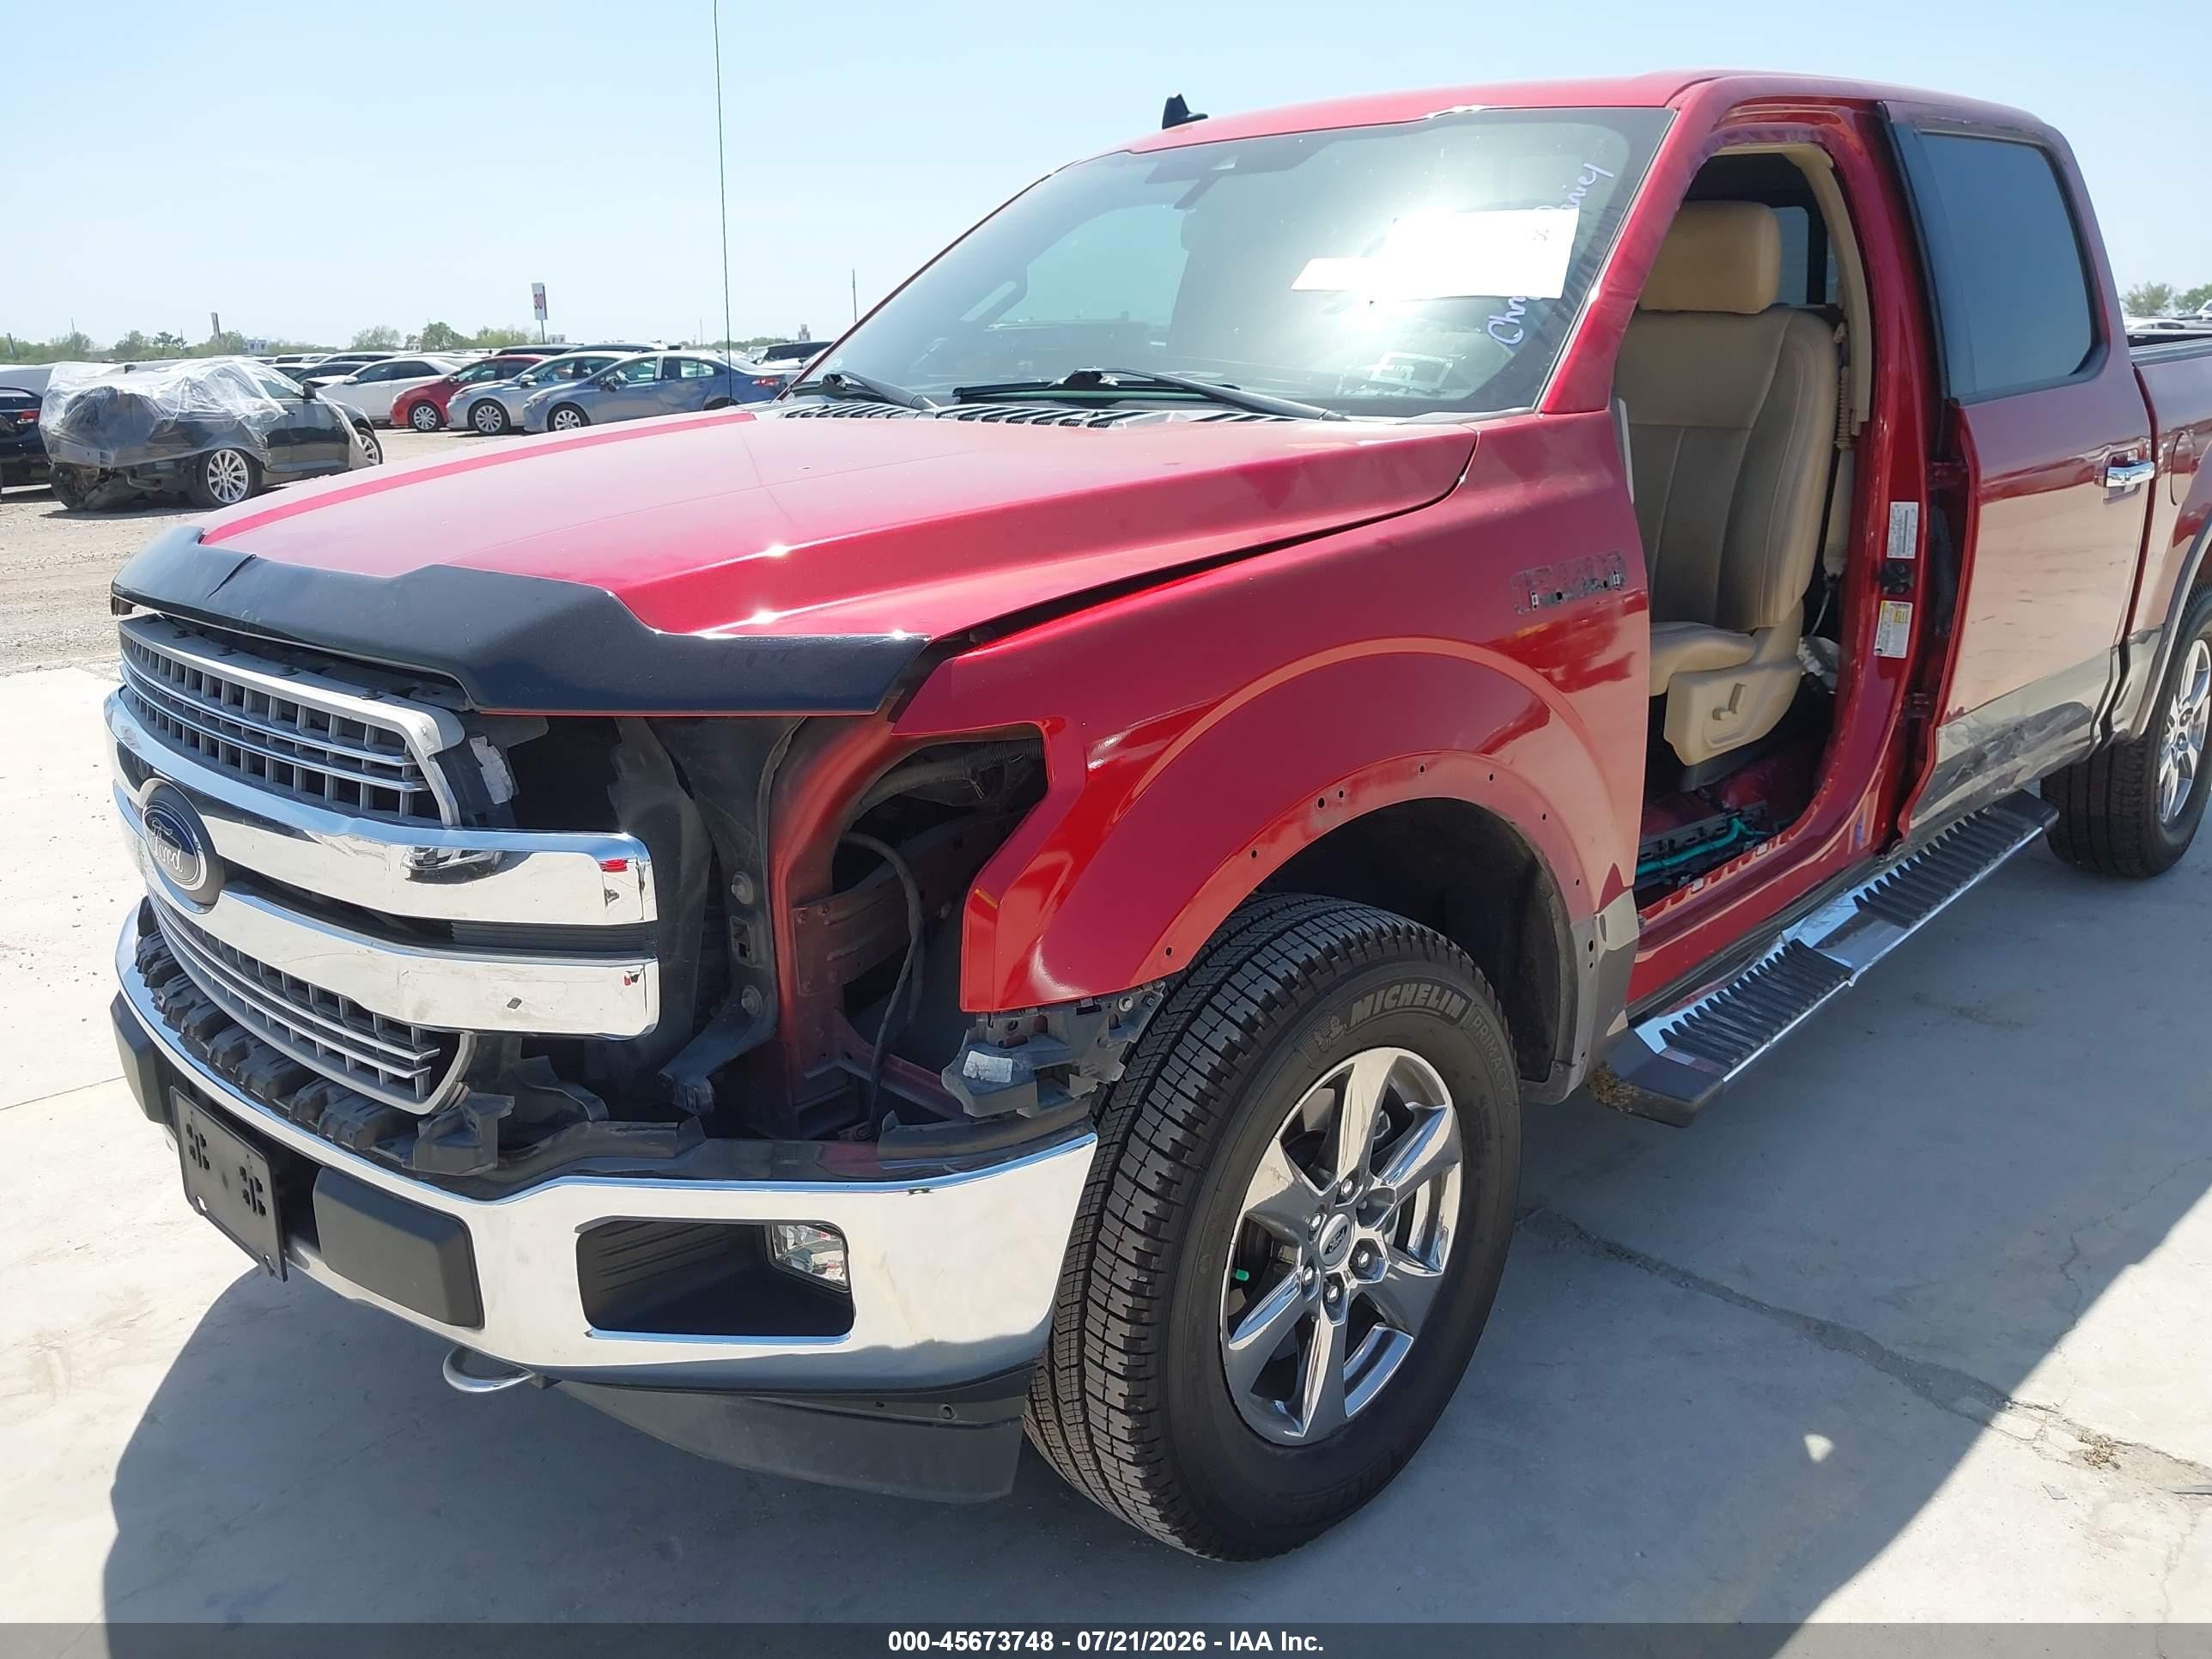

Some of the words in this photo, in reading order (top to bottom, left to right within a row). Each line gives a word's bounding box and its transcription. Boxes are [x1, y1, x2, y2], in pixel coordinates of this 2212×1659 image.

[150, 817, 184, 873] Ford
[1349, 982, 1467, 1028] MICHELIN
[1469, 1015, 1512, 1092] PRIMACY
